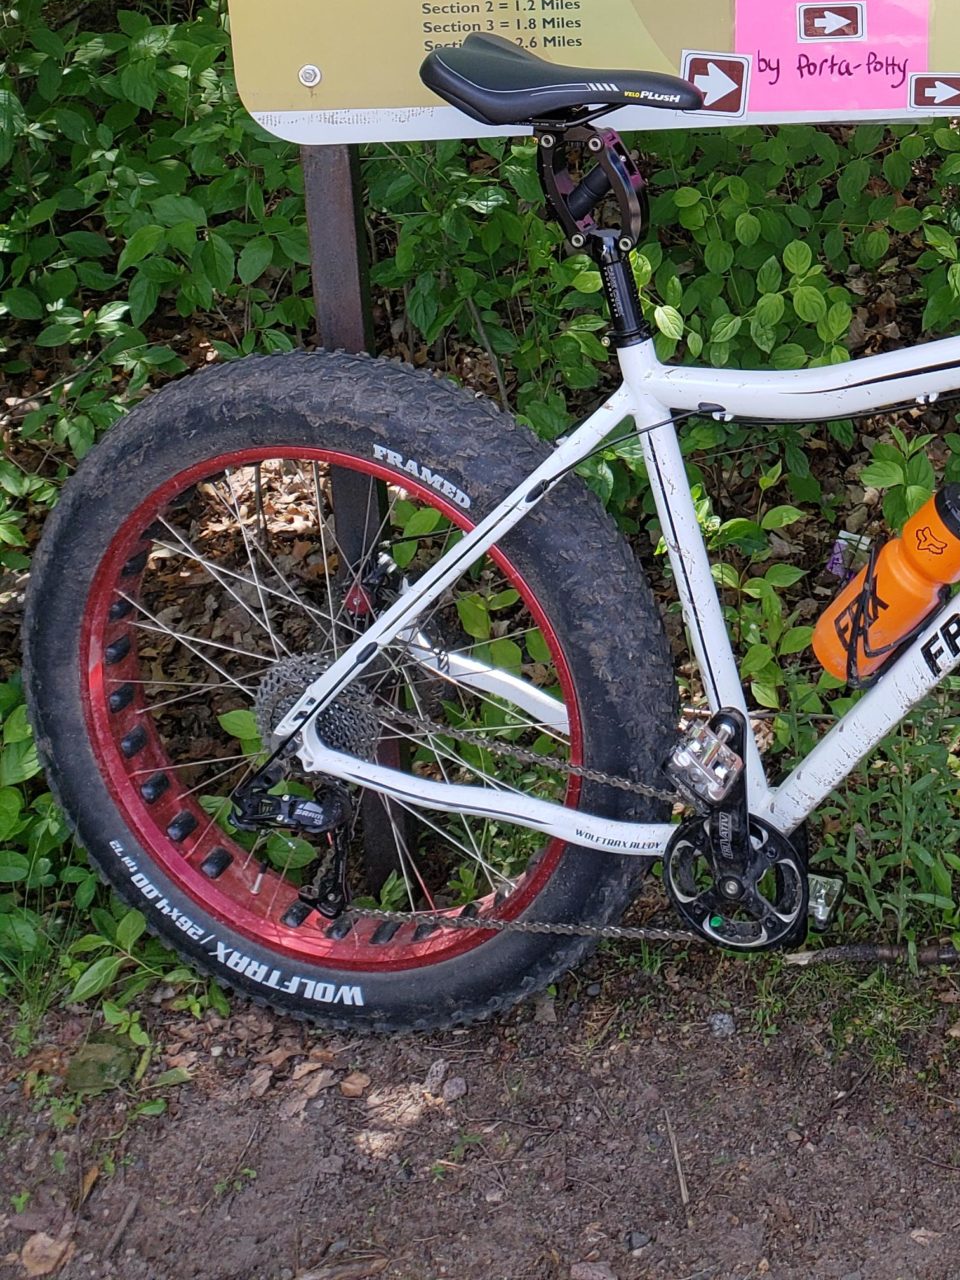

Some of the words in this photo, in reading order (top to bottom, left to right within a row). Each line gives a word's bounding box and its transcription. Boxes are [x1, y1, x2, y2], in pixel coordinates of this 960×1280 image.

[421, 1, 480, 14] Section
[515, 0, 536, 11] 1.2
[422, 20, 481, 33] Section
[516, 17, 537, 30] 1.8
[541, 16, 581, 29] Miles
[543, 35, 583, 48] Miles
[757, 50, 780, 85] by
[797, 51, 909, 89] Porta-Potty
[640, 90, 681, 103] PLUSH
[373, 444, 471, 509] FRAMED
[576, 828, 629, 849] WOLFTRAX
[209, 943, 365, 1007] WOLFTRAX
